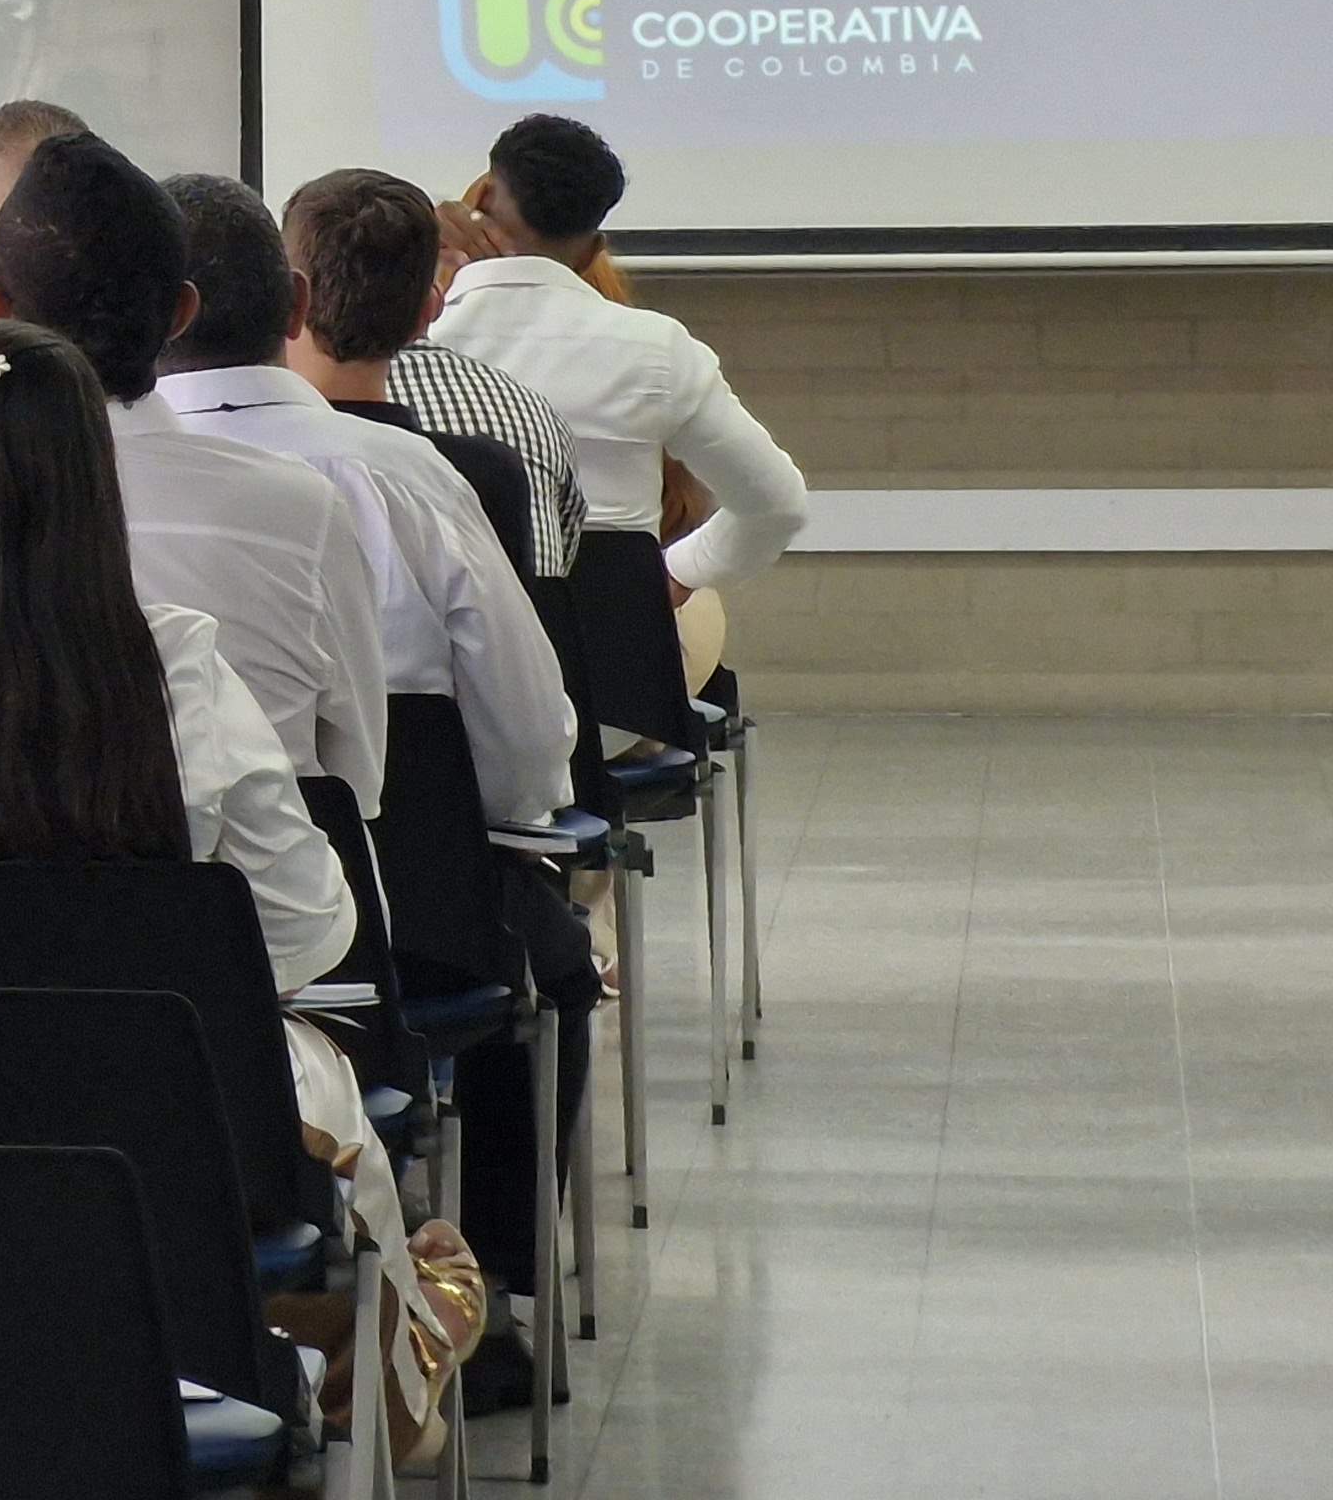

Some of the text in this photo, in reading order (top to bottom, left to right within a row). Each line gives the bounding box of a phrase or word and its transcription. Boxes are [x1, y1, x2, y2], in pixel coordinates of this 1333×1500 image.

[632, 4, 983, 48] COOPERATIVA
[642, 53, 975, 80] DE COLOMBIA
